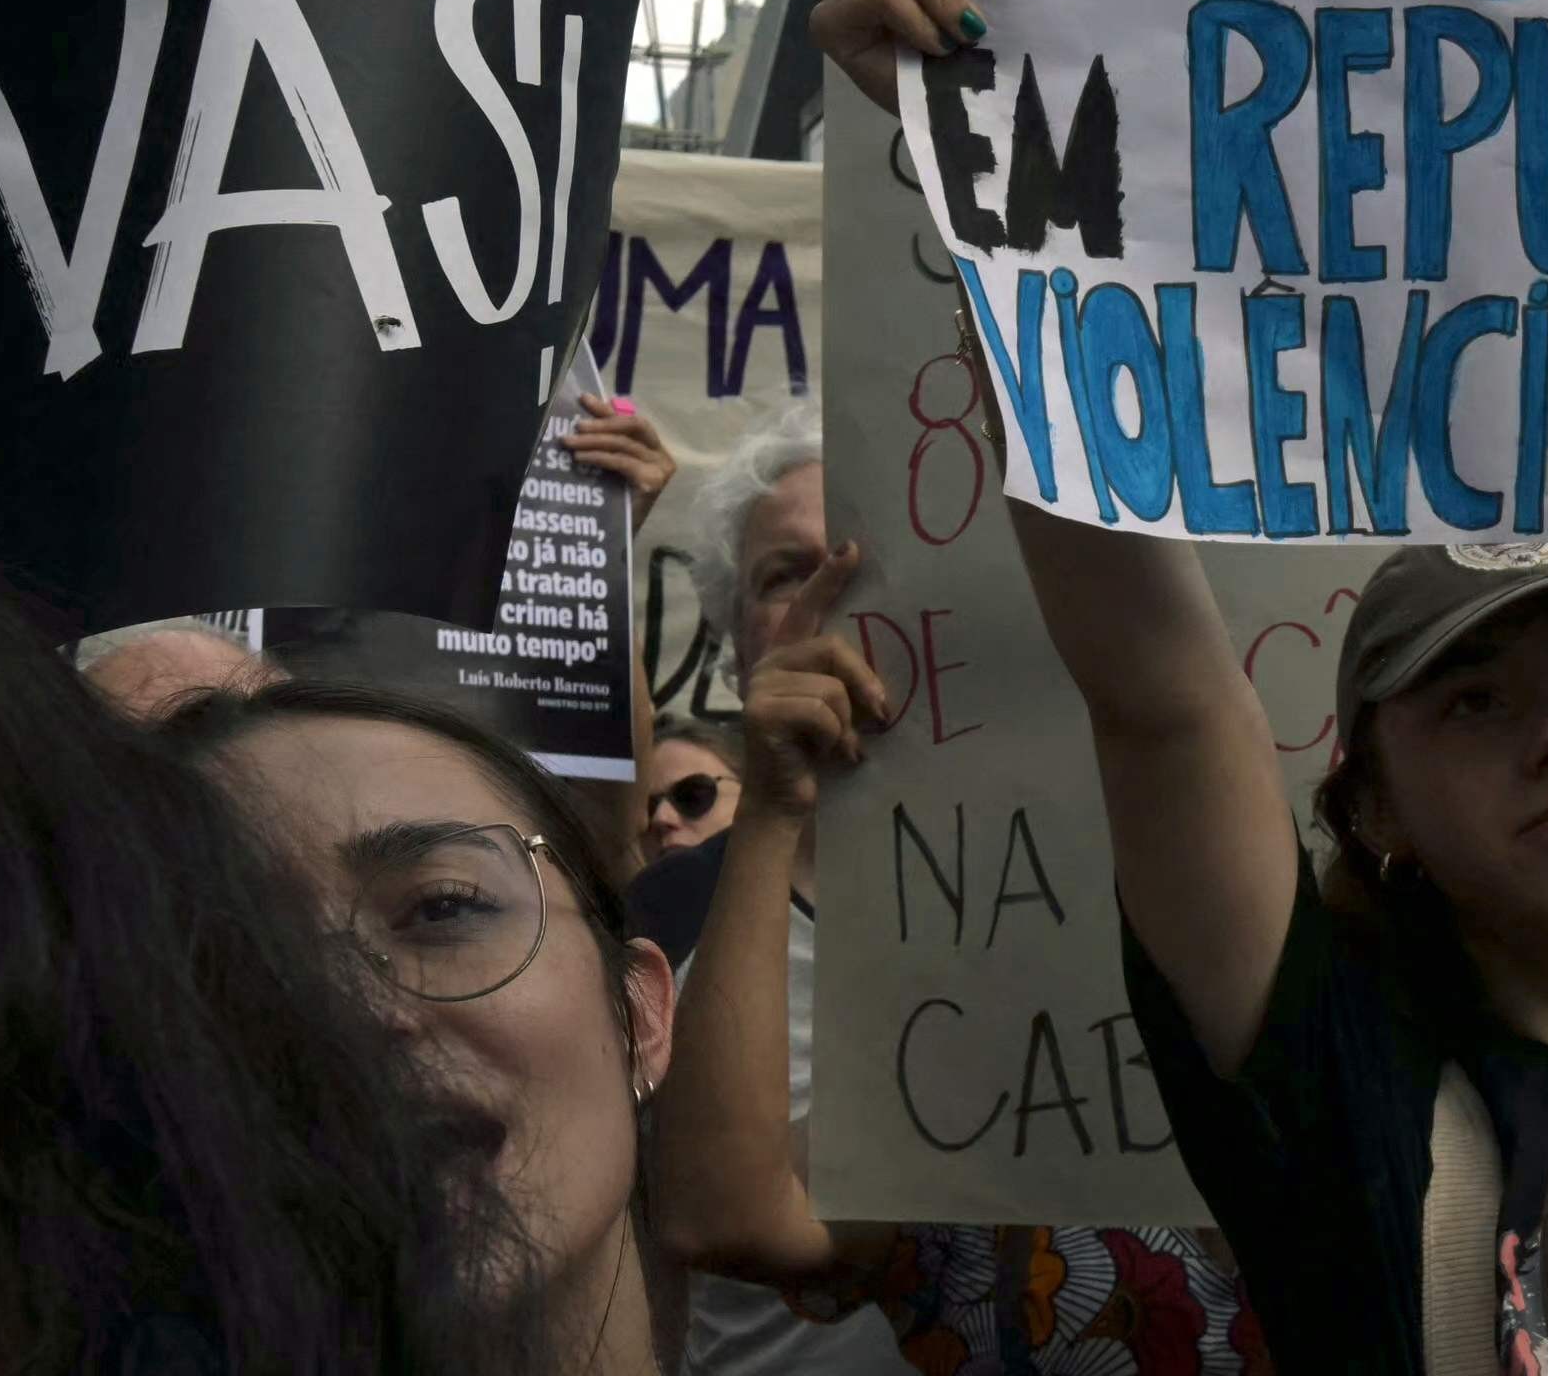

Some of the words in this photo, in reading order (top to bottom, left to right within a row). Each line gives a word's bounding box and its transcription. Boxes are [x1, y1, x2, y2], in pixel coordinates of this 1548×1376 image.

[922, 47, 1124, 260] EM
[520, 477, 605, 507] omens
[532, 536, 556, 569] já
[561, 542, 607, 568] não
[517, 568, 608, 600] tratado
[500, 598, 573, 627] crime
[577, 603, 609, 631] há
[515, 632, 609, 667] tempo"
[493, 671, 551, 692] Roberto
[554, 676, 610, 696] Barroso
[891, 802, 1066, 950] NA
[895, 997, 1174, 1159] CAB
